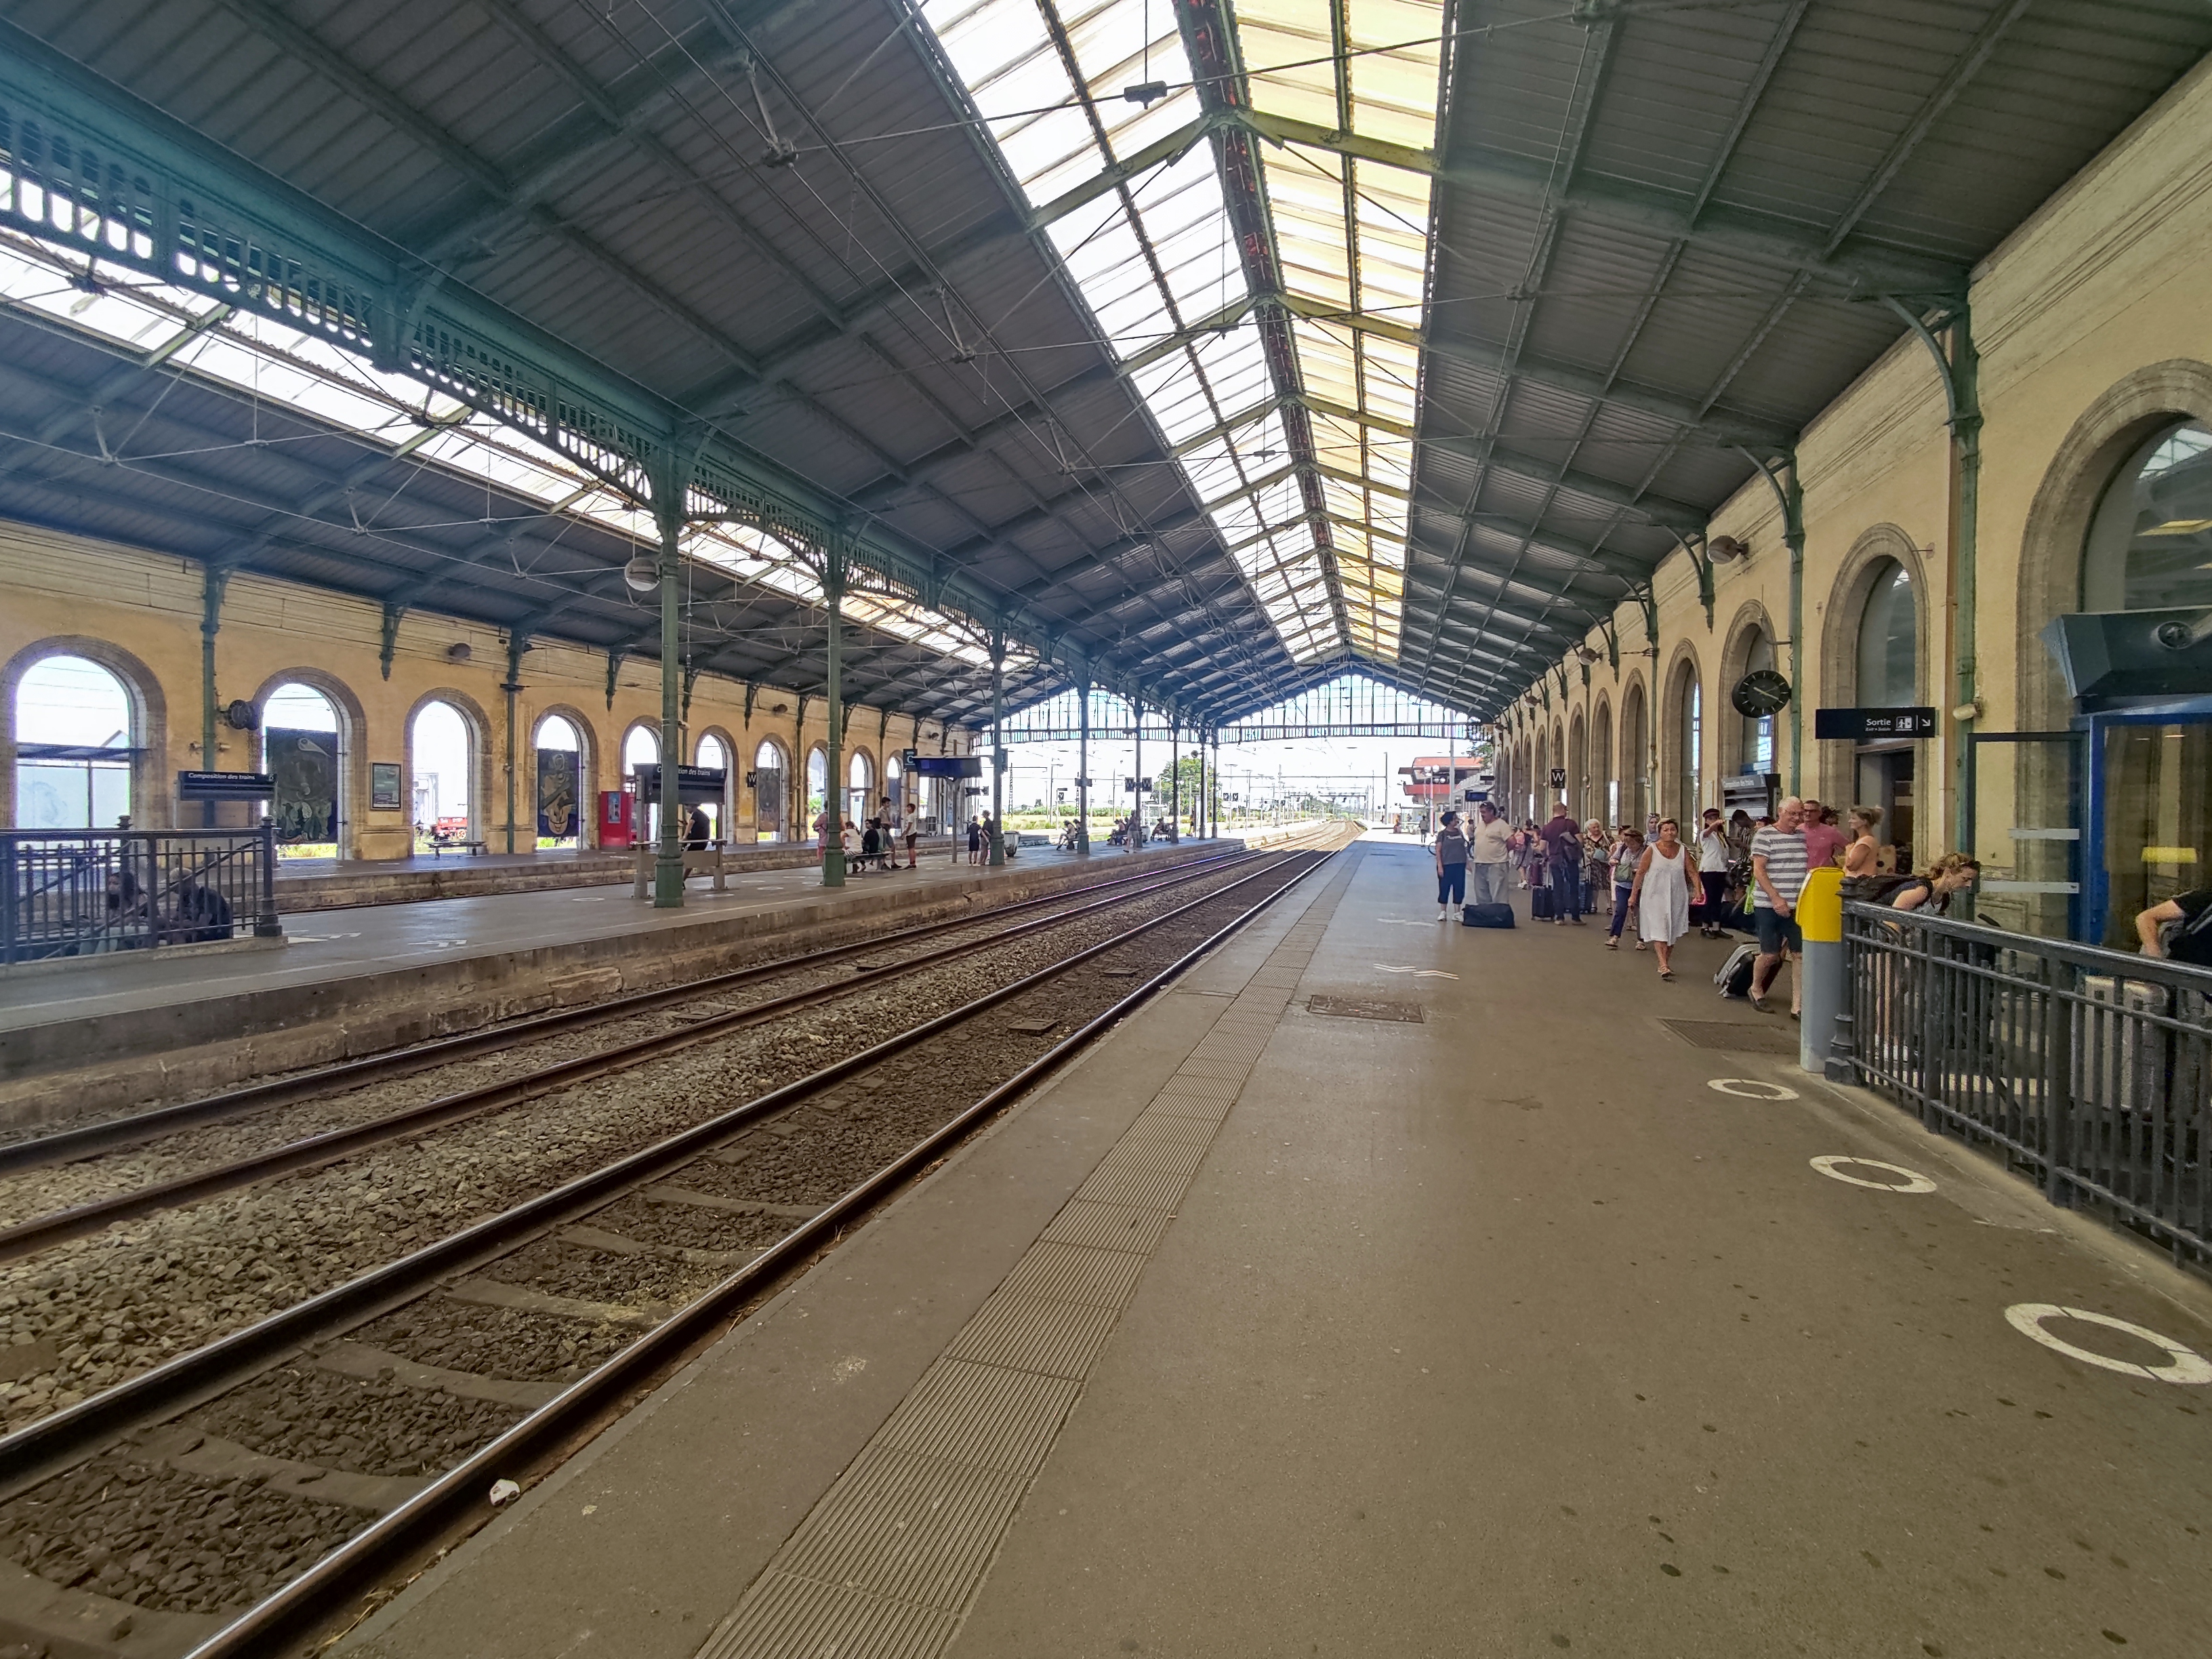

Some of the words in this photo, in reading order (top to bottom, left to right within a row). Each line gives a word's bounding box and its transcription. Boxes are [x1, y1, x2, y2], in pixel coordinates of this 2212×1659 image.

[747, 774, 757, 783] W
[1552, 772, 1565, 781] W
[1126, 779, 1134, 787] W
[1143, 779, 1151, 787] W
